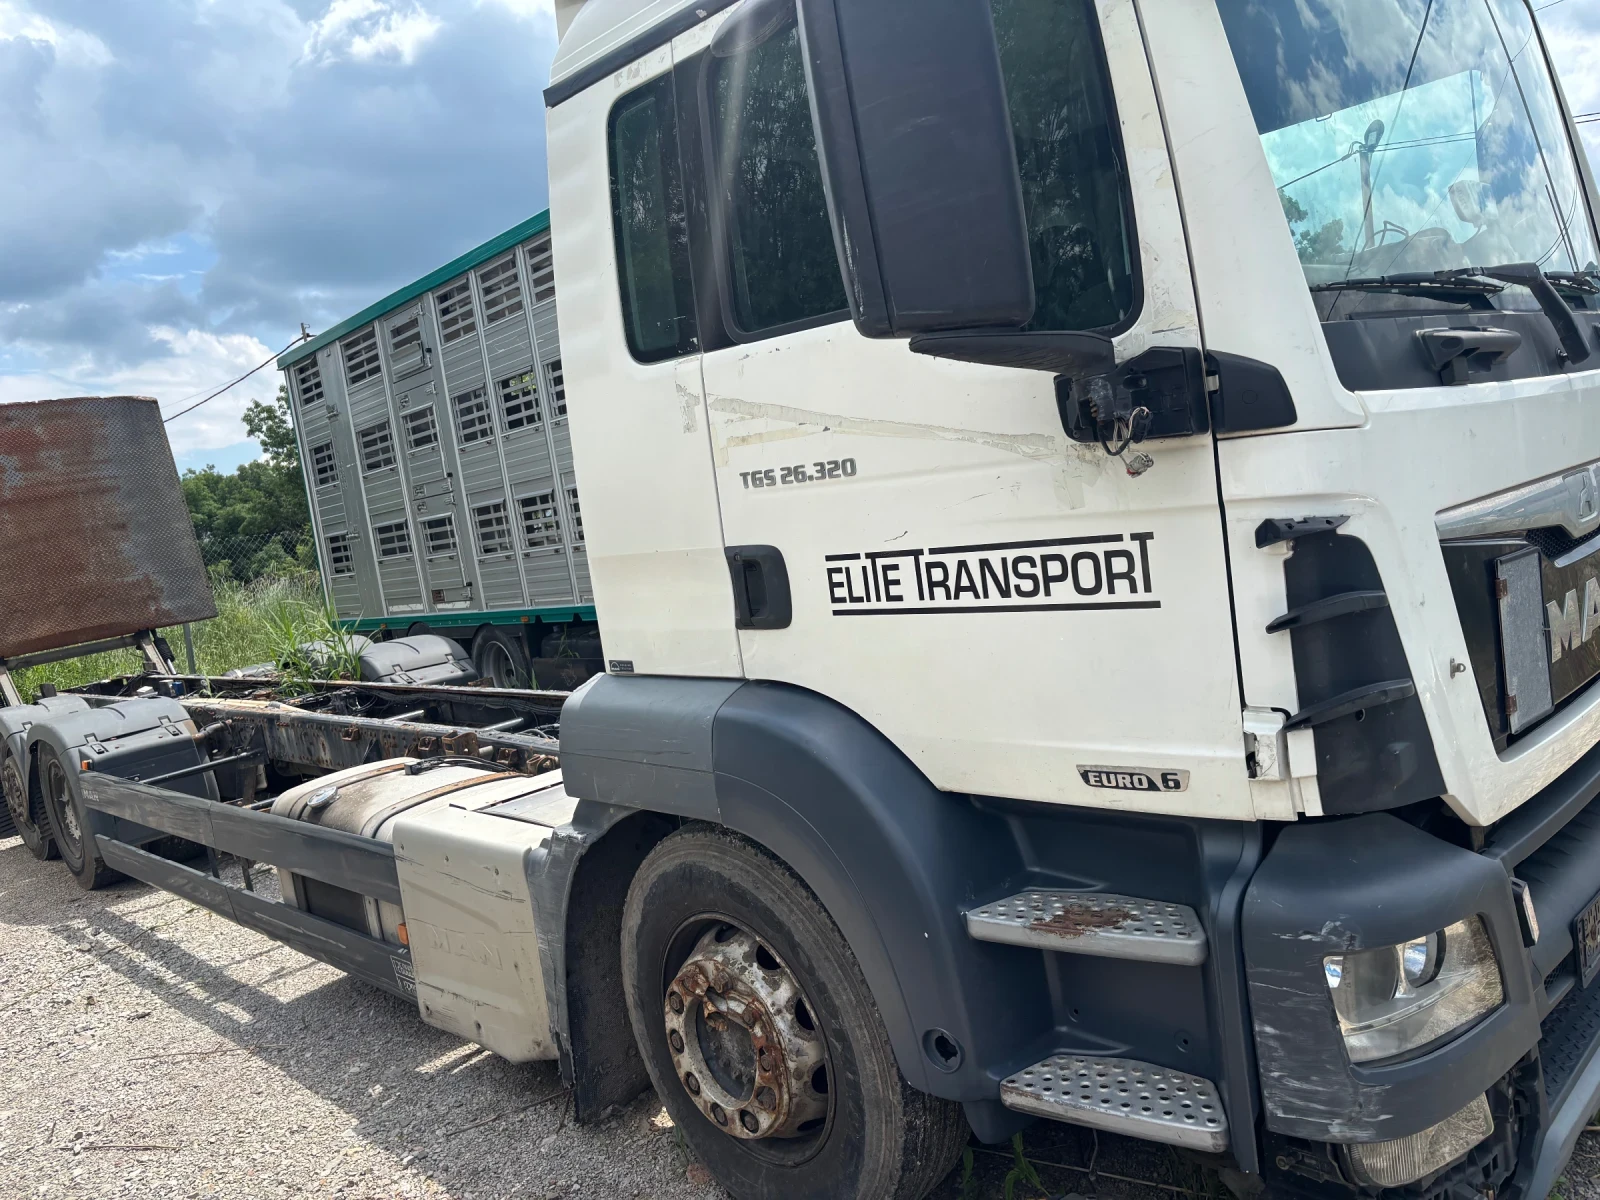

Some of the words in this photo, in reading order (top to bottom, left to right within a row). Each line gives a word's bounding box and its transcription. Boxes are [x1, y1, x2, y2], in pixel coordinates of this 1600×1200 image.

[739, 469, 776, 489] TGS
[780, 458, 857, 484] 26.320
[898, 531, 1154, 601] TRANSPORT
[1088, 771, 1149, 789] EURO
[1161, 772, 1181, 789] 6
